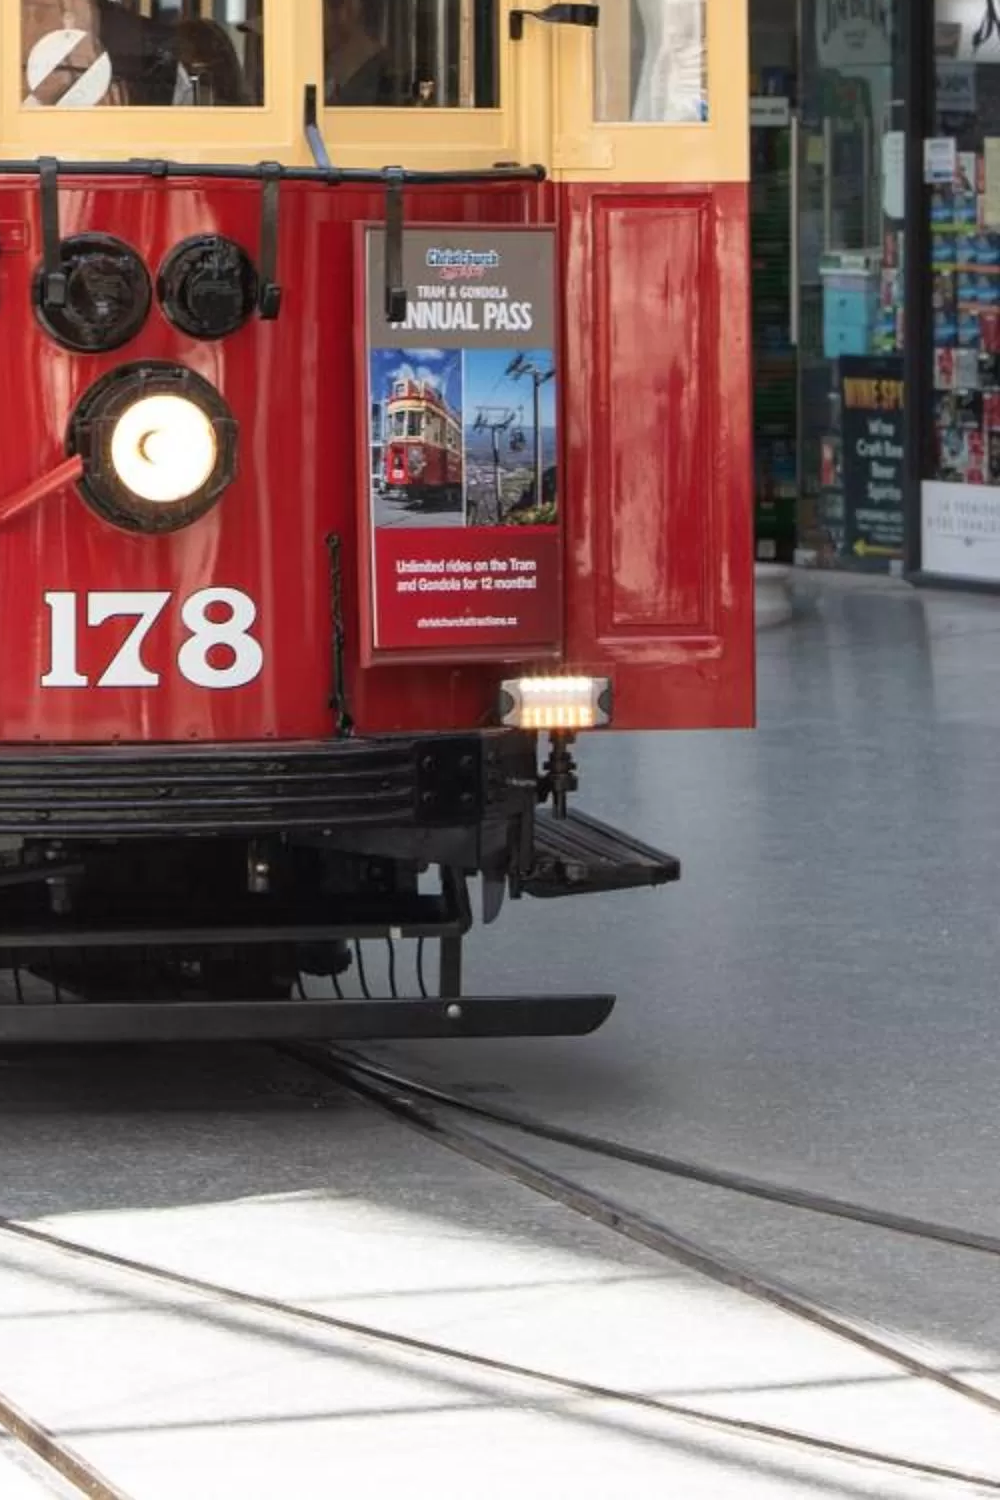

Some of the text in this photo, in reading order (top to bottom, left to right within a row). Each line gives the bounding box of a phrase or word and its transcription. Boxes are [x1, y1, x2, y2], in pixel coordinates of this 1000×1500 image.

[416, 285, 446, 300] TRAM
[459, 285, 509, 299] GONDOLA
[483, 302, 534, 332] PASS
[396, 557, 537, 574] Unlimited rides on the Tram
[396, 577, 417, 592] and
[418, 576, 461, 592] Gondola
[462, 576, 478, 591] for
[480, 576, 493, 590] 12
[40, 587, 264, 689] 178
